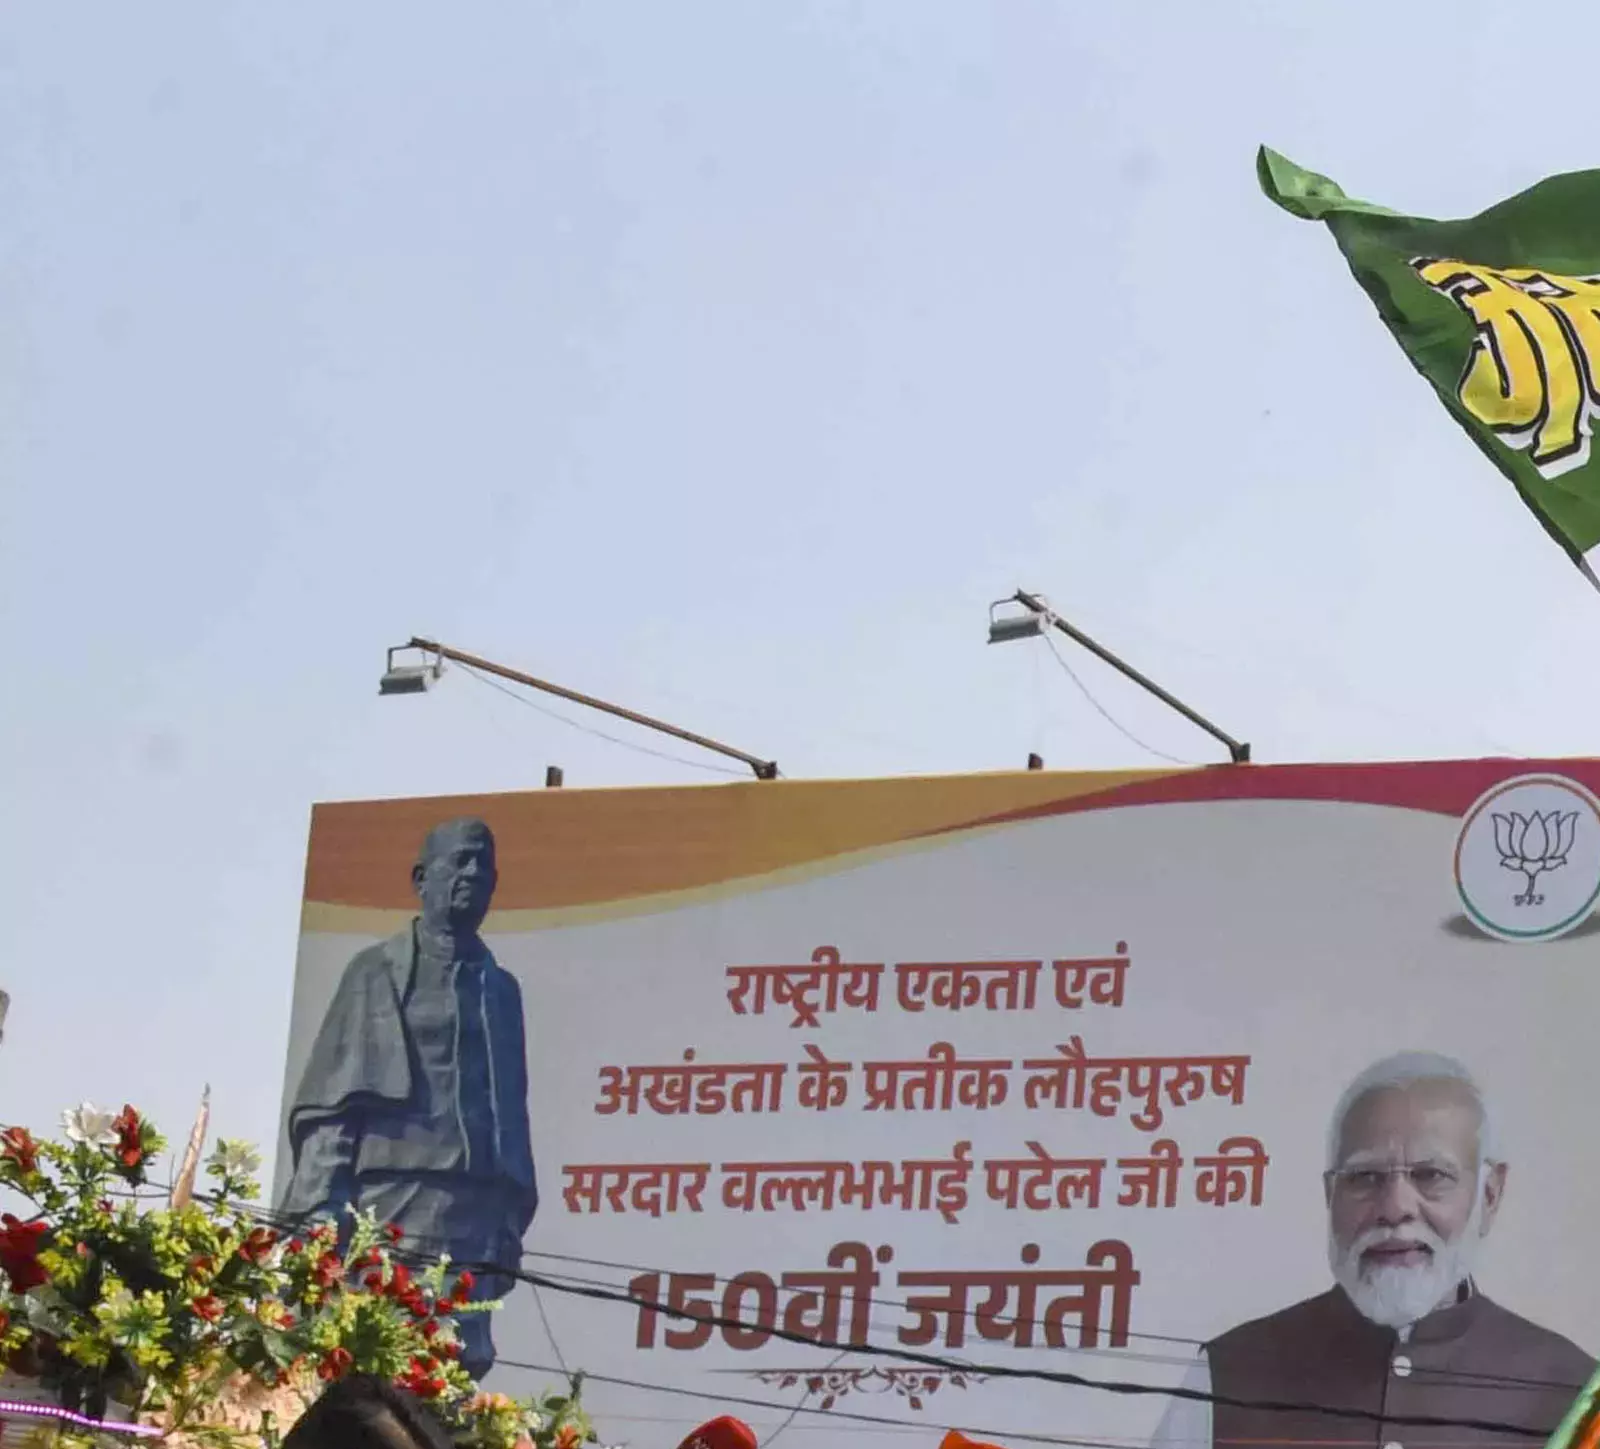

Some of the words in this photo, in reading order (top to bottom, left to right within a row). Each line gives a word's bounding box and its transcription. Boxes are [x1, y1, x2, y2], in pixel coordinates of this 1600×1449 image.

[726, 945, 885, 1029] राष्ट्रीय
[895, 960, 1043, 1013] एकता
[1052, 940, 1131, 1010] एवं
[594, 1046, 789, 1116] अखंडता
[797, 1043, 853, 1112] के
[862, 1040, 1013, 1112] प्रतीक
[1022, 1034, 1252, 1132] लौहपुरुष
[561, 1162, 712, 1218] सरदार
[720, 1140, 974, 1224] वल्लभभाई
[983, 1140, 1107, 1210] पटेल
[1116, 1138, 1184, 1209] जी
[1193, 1135, 1270, 1207] की
[628, 1240, 894, 1351] 150वीं
[897, 1239, 1141, 1350] जयंती
